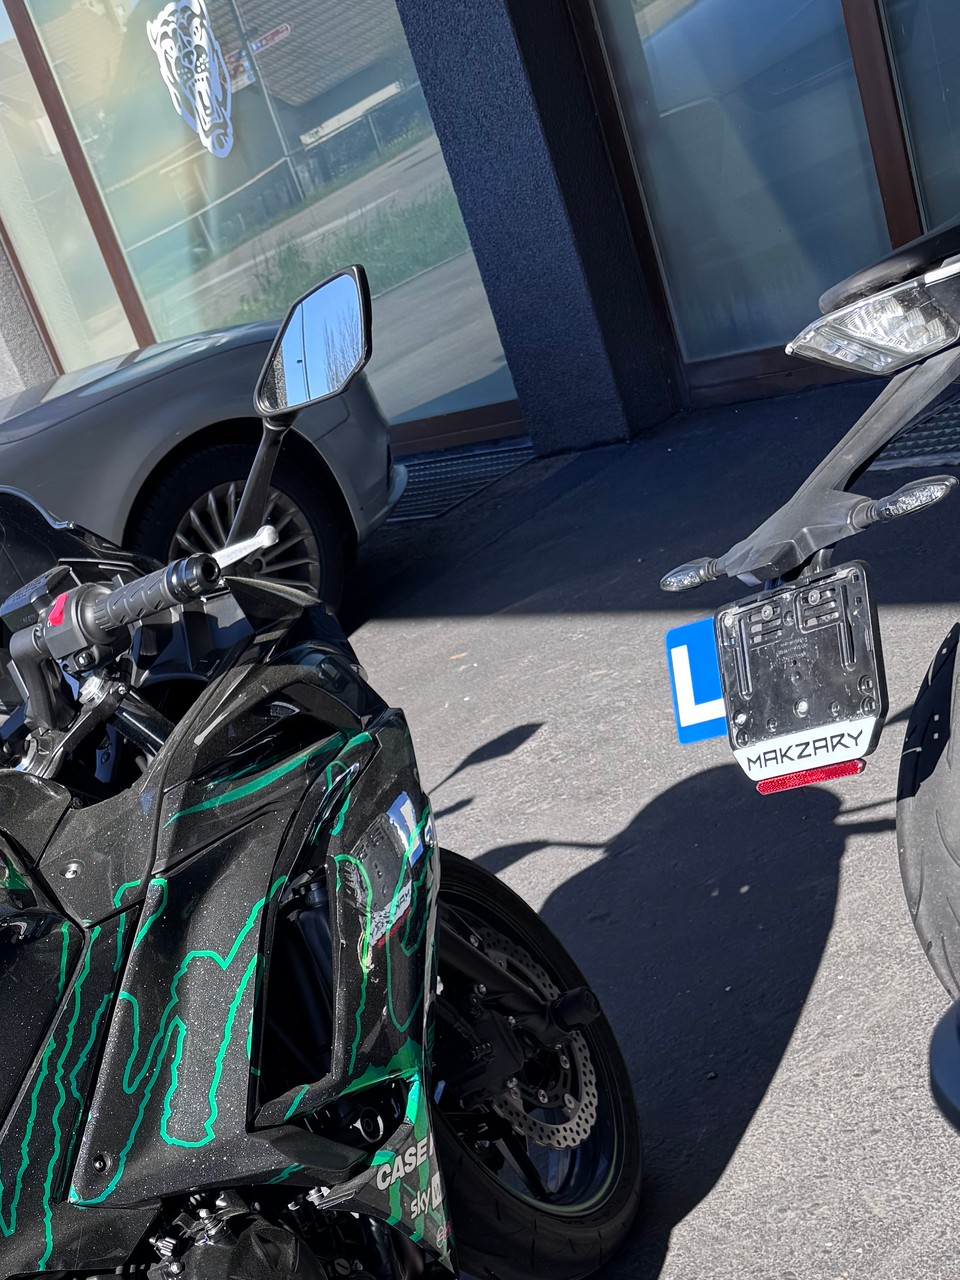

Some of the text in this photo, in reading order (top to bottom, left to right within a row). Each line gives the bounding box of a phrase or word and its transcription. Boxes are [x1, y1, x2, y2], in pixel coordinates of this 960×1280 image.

[671, 644, 725, 727] L
[747, 729, 863, 771] MAKZARY
[376, 1136, 427, 1190] CASE
[410, 1187, 430, 1220] sky
